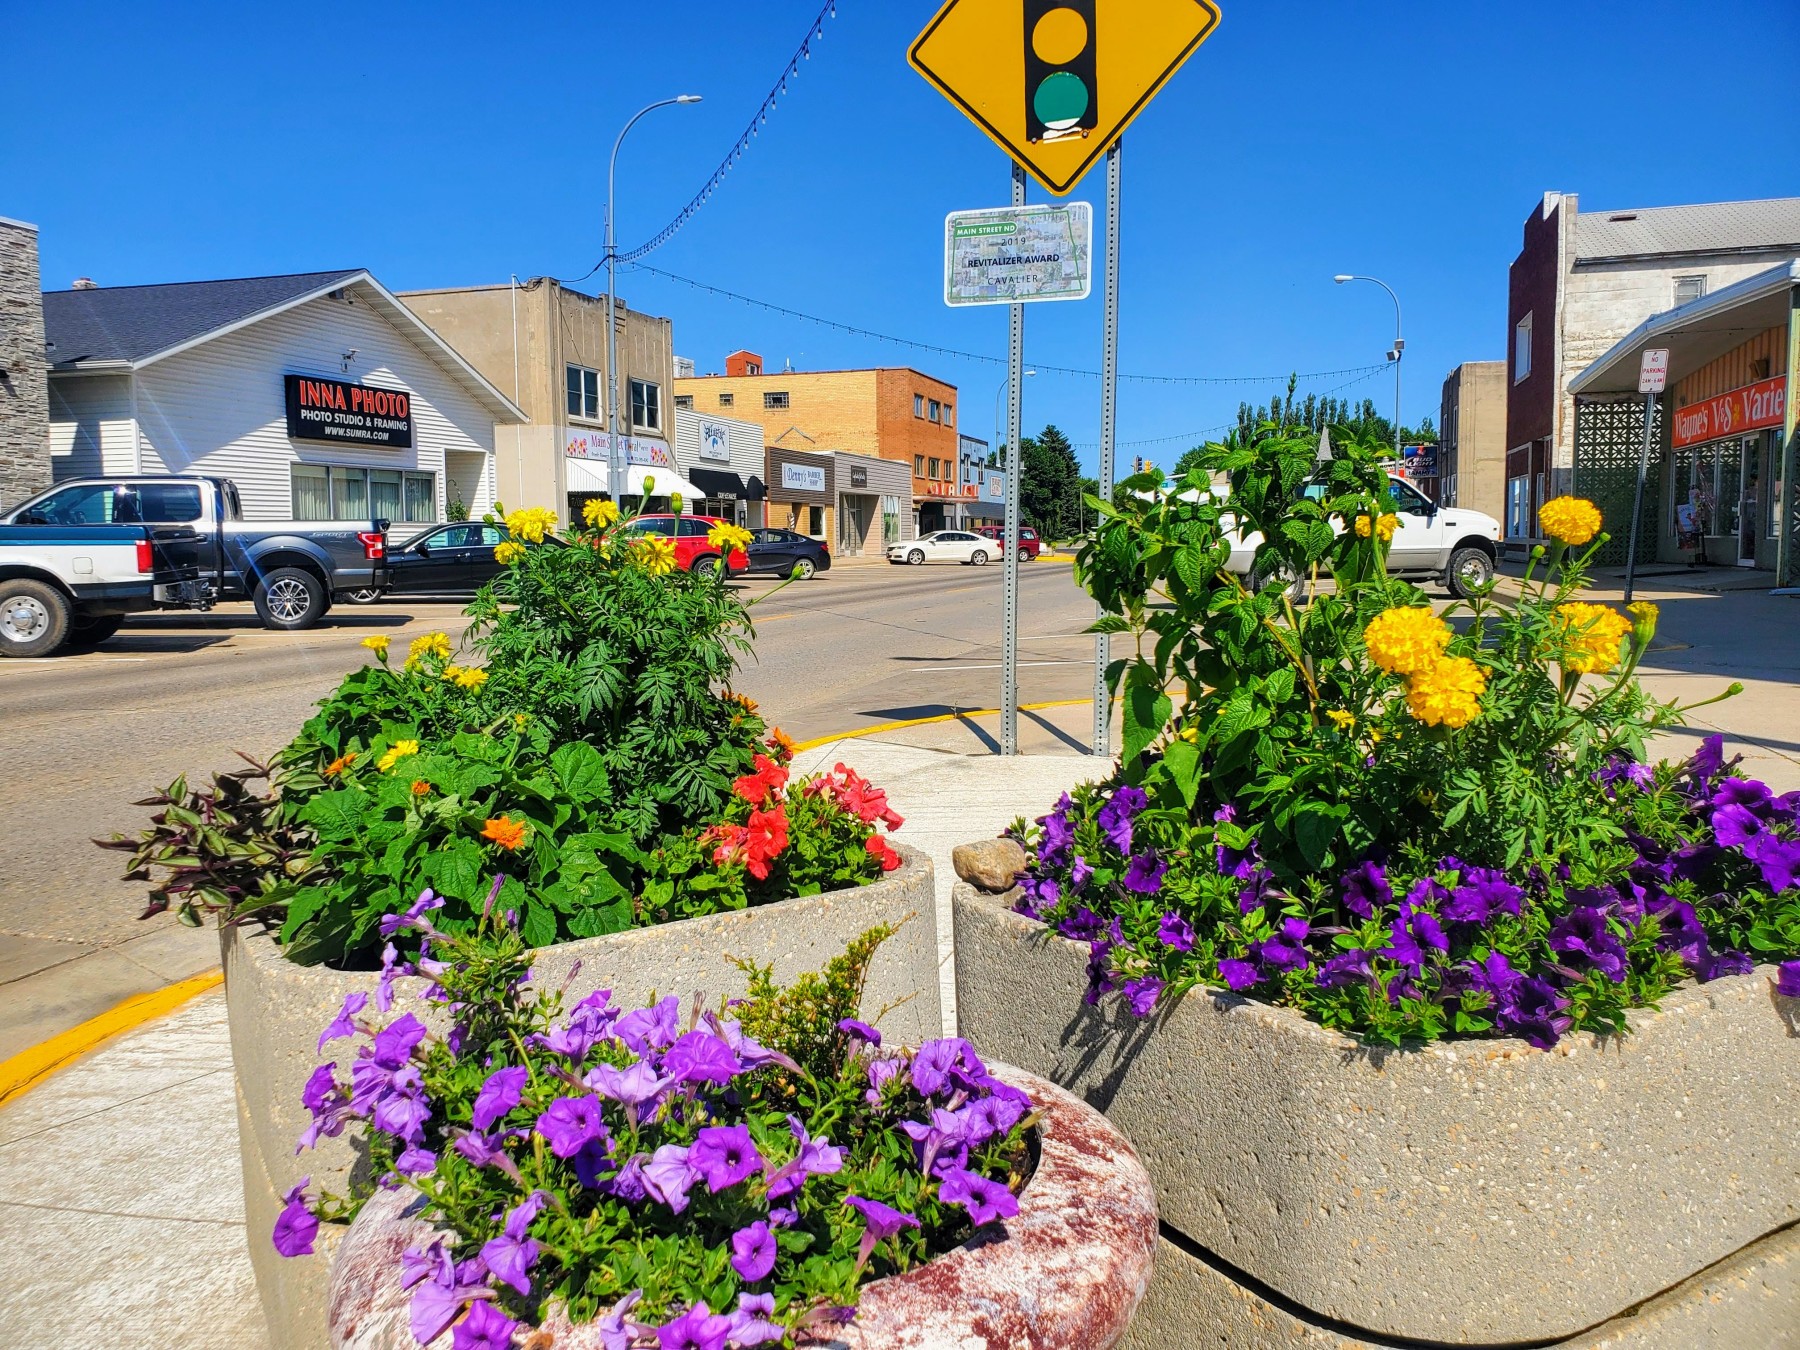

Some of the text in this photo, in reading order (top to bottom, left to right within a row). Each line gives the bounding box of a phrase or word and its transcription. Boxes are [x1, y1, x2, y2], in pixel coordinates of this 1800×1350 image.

[956, 224, 1015, 235] MAIN STREET ND
[1001, 236, 1026, 246] 2019
[967, 253, 1060, 268] REVITALIZER AWARD
[987, 274, 1039, 285] CAVALIER
[299, 379, 408, 418] INNA PHOTO
[1674, 381, 1786, 443] Wayne's V&S Varie
[300, 409, 408, 431] PHOTO STUDIO & FRAMING
[324, 426, 389, 441] WWW.SUMRA.COM
[591, 434, 605, 448] Main
[787, 467, 807, 487] Denny's
